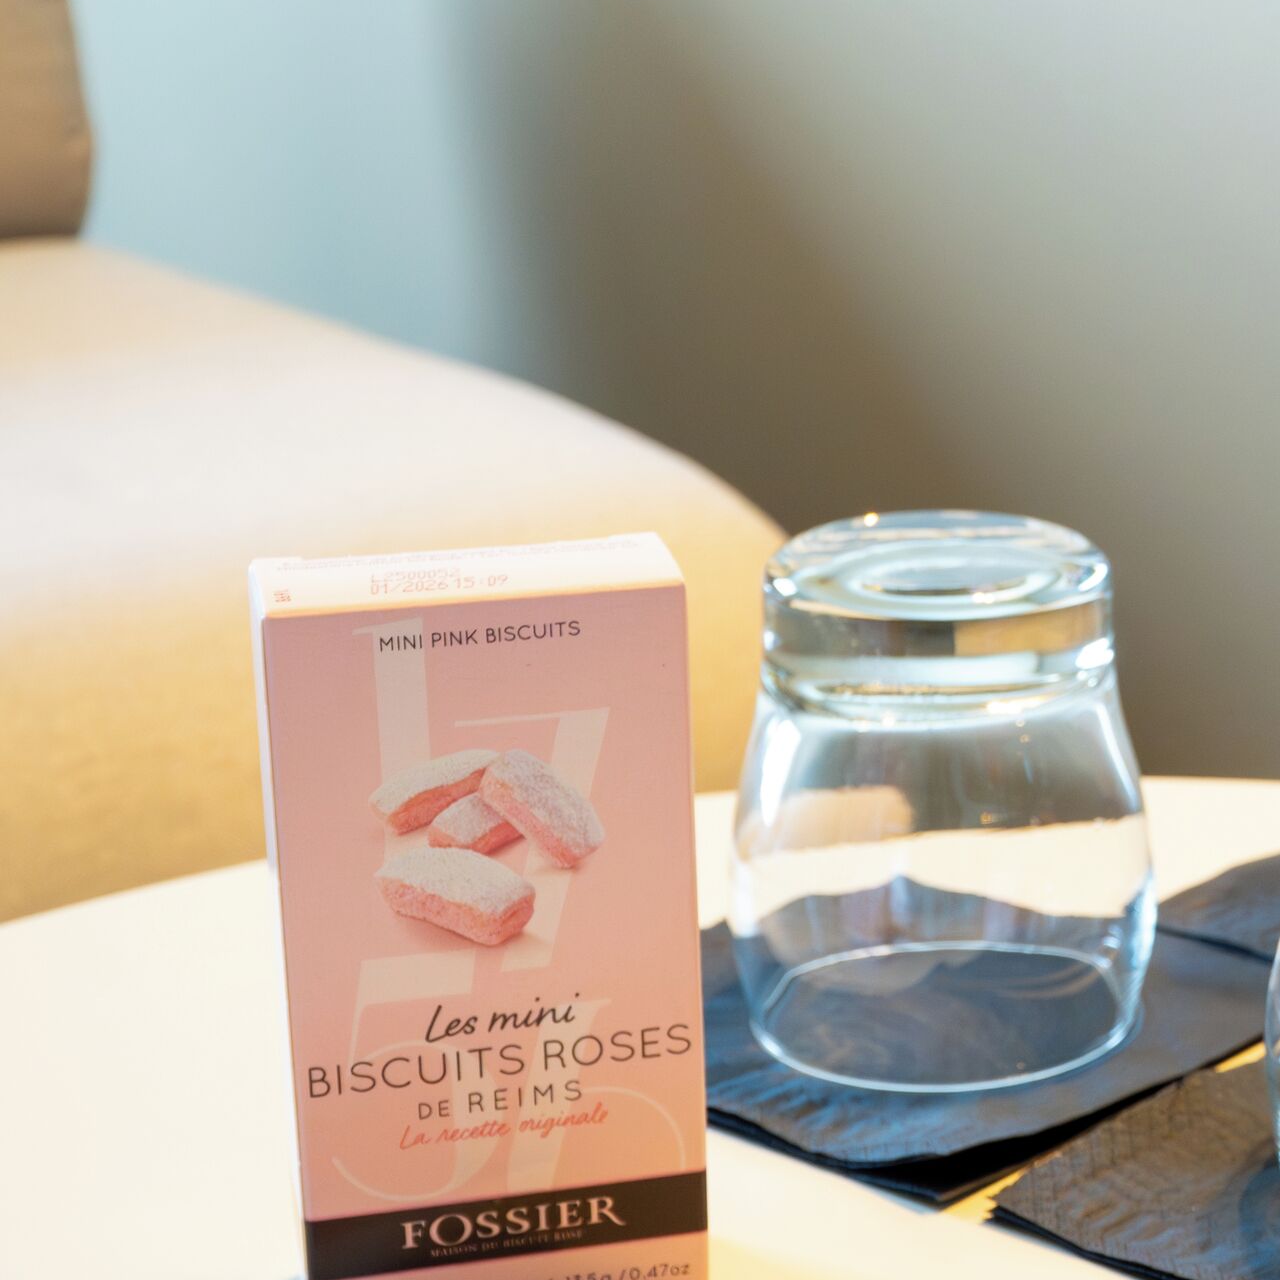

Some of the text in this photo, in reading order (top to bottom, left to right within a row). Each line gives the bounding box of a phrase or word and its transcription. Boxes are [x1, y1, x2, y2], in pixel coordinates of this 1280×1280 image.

[370, 580, 449, 596] 01/2026
[379, 620, 582, 652] MINI PINK BISCUITS
[425, 993, 580, 1043] Les mini
[308, 1023, 692, 1099] BISCUITS ROSES
[418, 1080, 583, 1120] DE REIMS
[400, 1102, 609, 1150] La recette originale
[401, 1196, 627, 1249] FOSSIER
